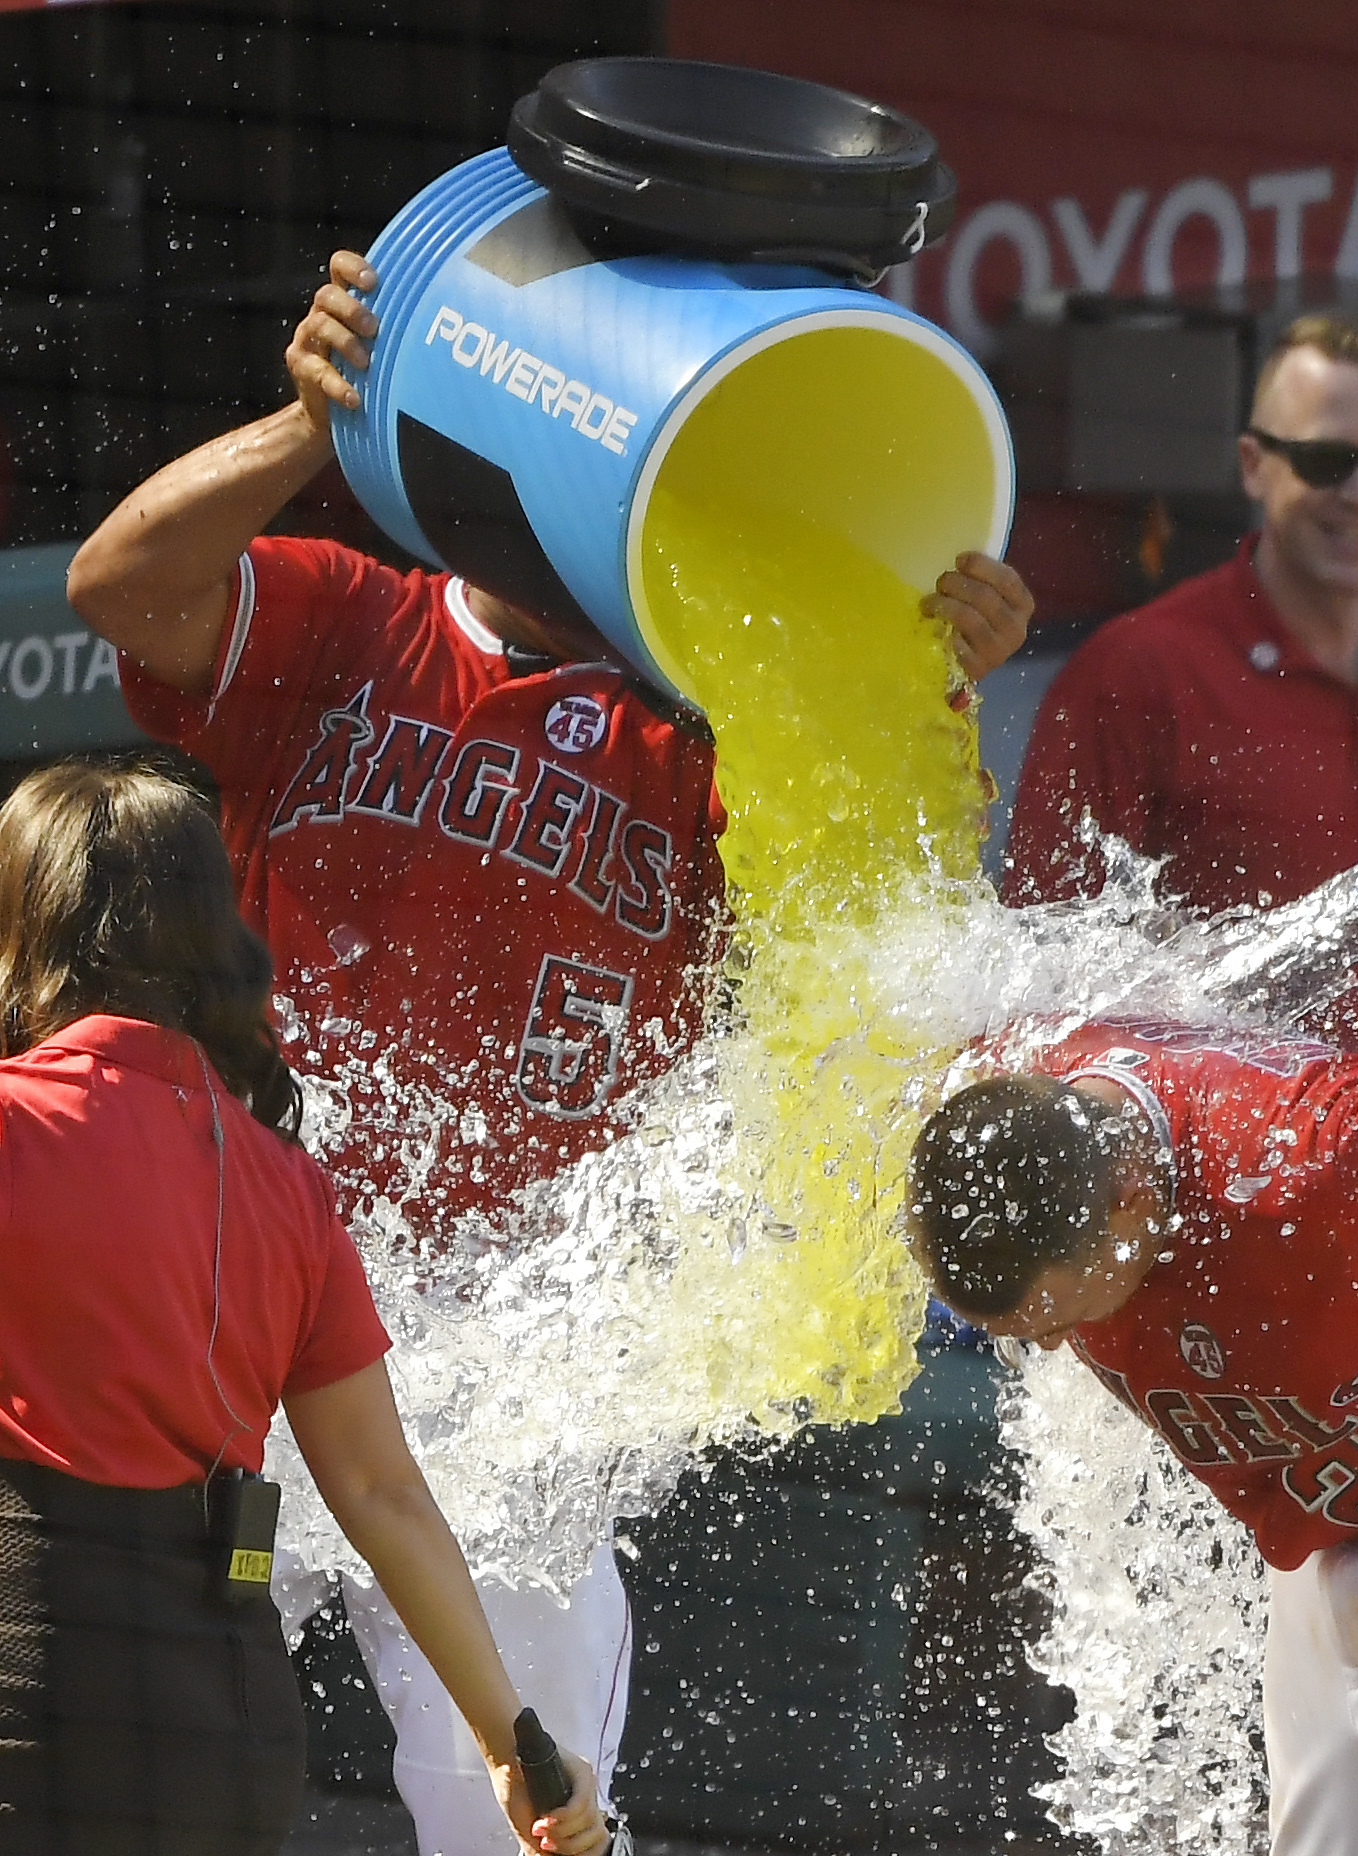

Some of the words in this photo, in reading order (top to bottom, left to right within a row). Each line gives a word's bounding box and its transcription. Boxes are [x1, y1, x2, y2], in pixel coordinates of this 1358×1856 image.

[425, 305, 639, 456] POWERADE
[0, 632, 122, 699] OTA
[547, 714, 598, 748] 45
[270, 680, 673, 942] ANGELS
[518, 952, 635, 1120] 5
